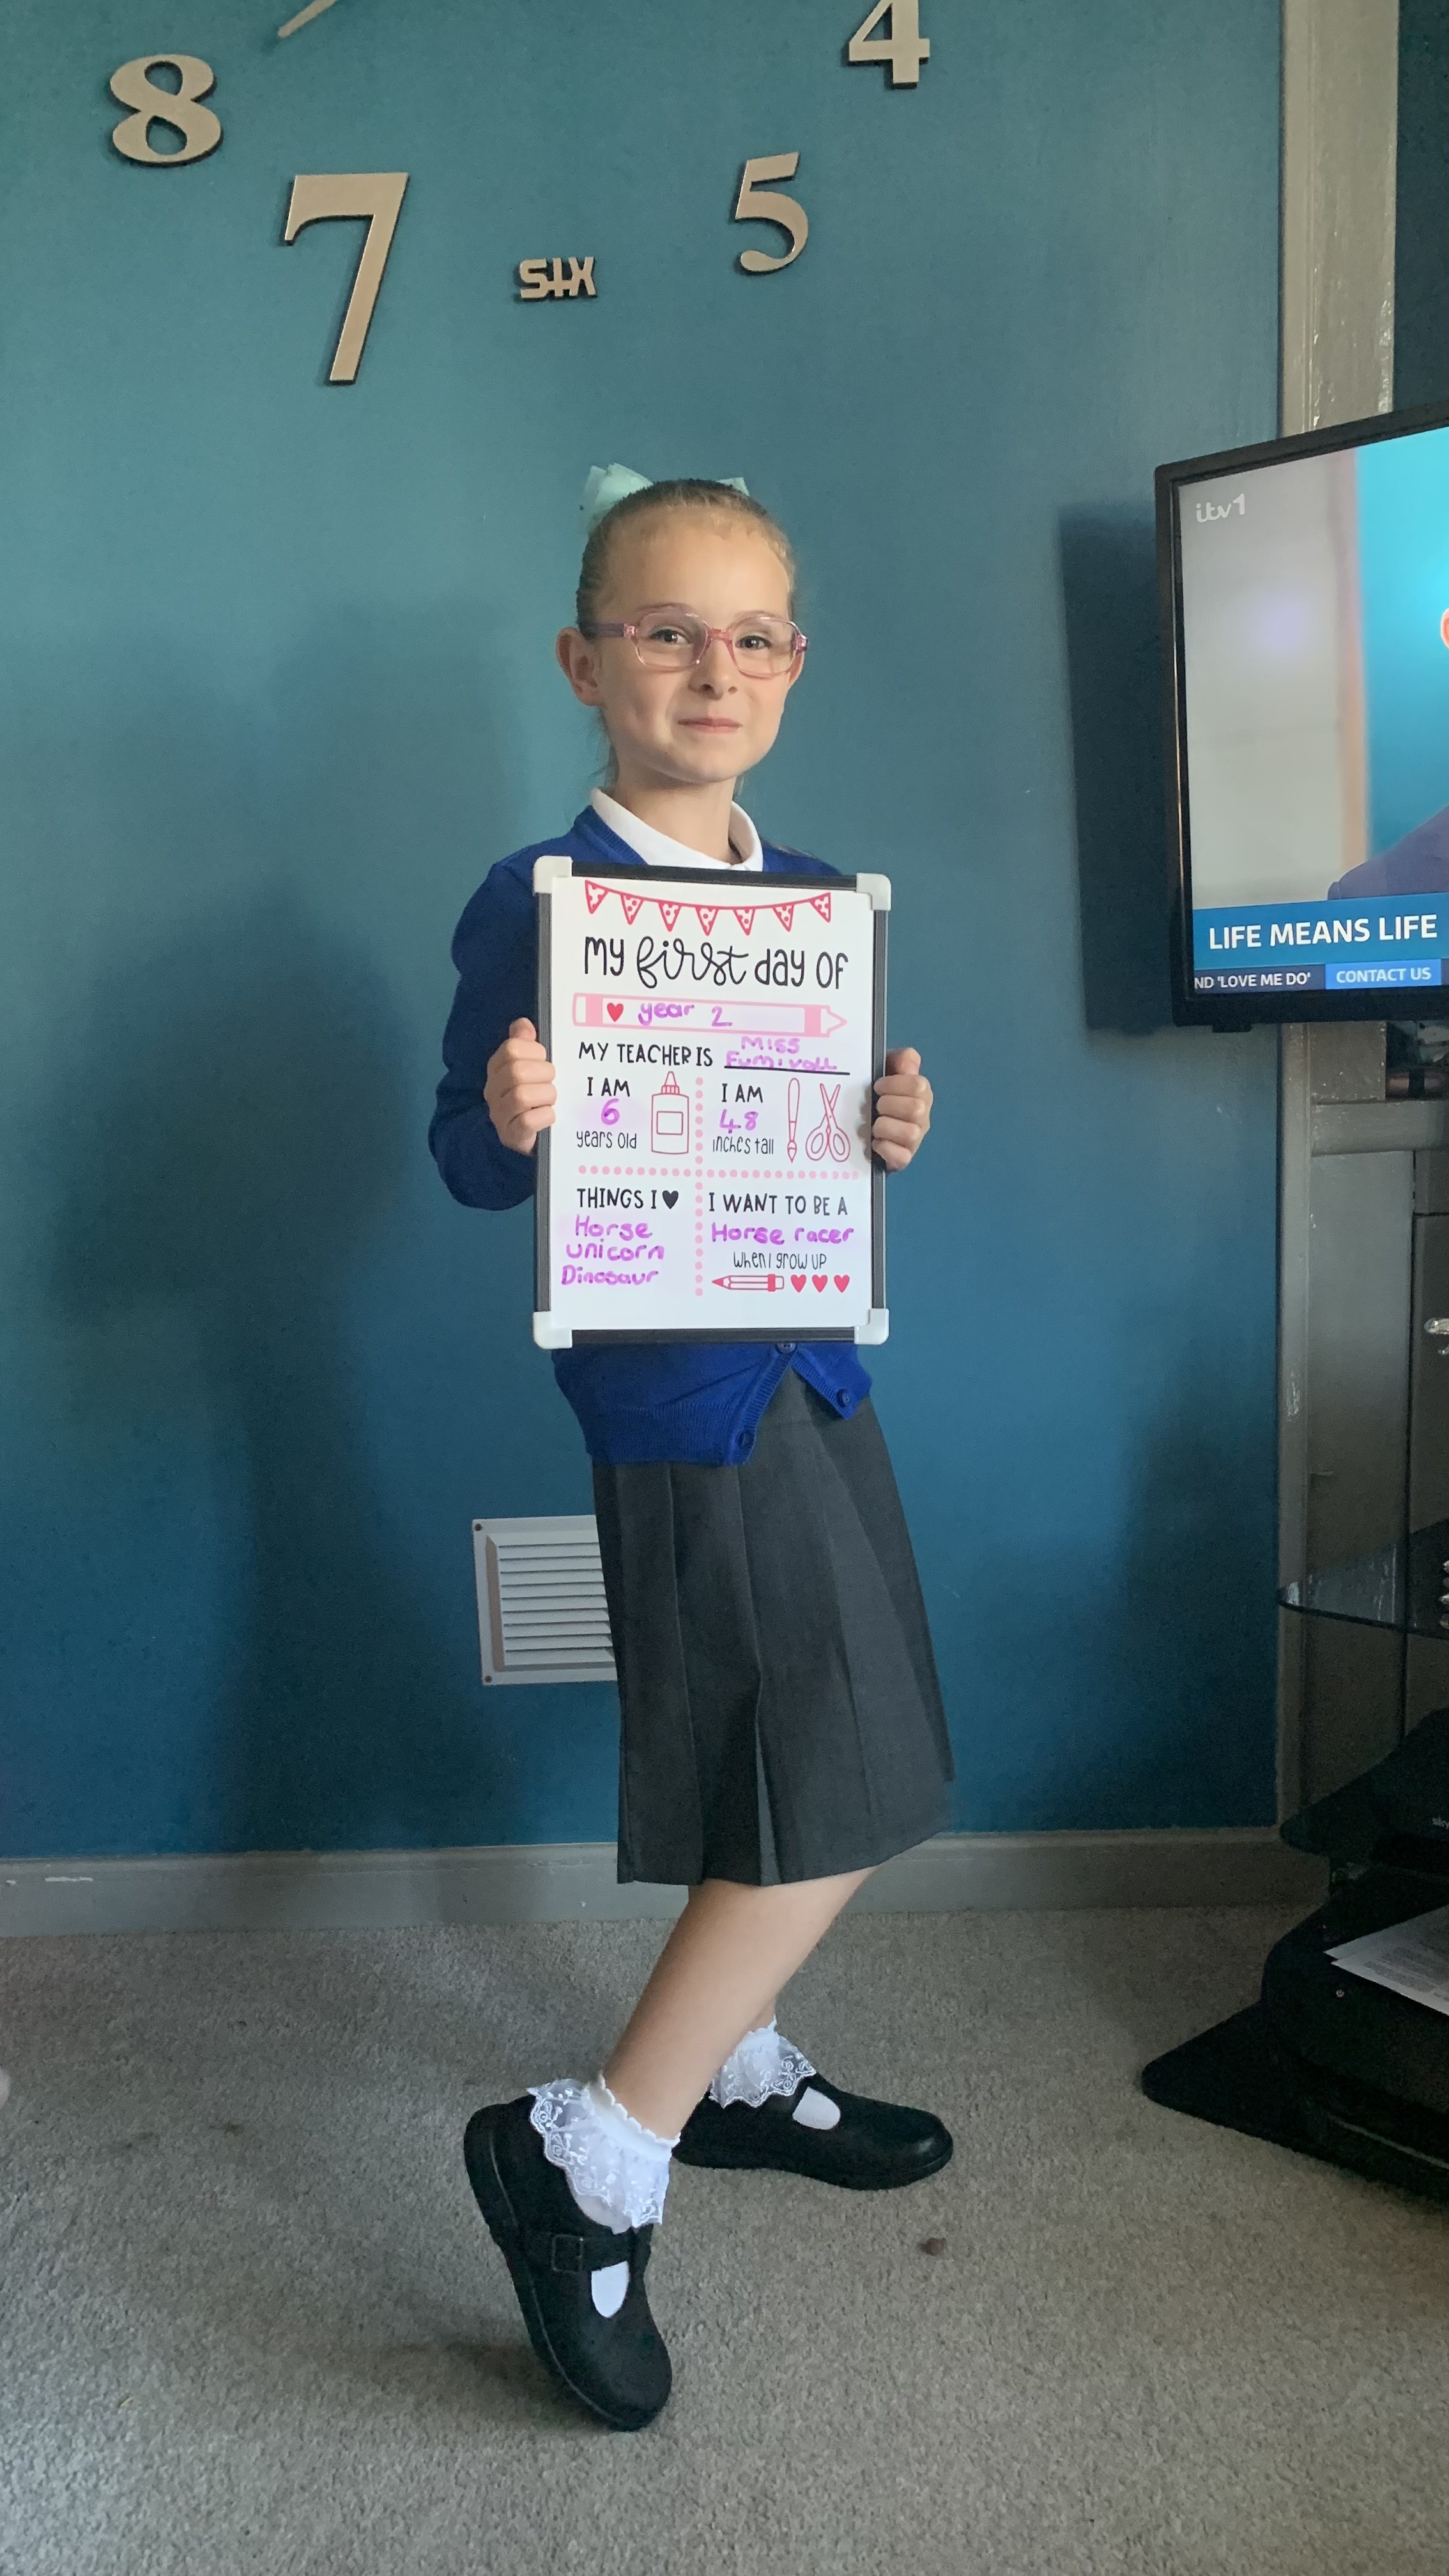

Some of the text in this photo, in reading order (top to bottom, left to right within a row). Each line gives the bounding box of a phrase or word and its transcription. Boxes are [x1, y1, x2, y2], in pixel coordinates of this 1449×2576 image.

[849, 0, 930, 84] 4
[109, 54, 222, 165] 8
[735, 151, 809, 273] 5
[284, 172, 410, 383] 7
[519, 256, 597, 298] SIX
[1195, 493, 1246, 523] itv1
[1209, 914, 1438, 949] LIFE MEANS LIFE
[636, 935, 749, 989] first
[754, 948, 805, 987] day
[1261, 973, 1283, 986] ME
[1336, 967, 1432, 984] CONTACT US
[638, 1002, 733, 1027] year 2
[578, 1041, 714, 1067] MY TEACHER IS
[586, 1077, 631, 1097] I AM
[721, 1083, 763, 1103] I AM
[601, 1098, 620, 1126] 6
[719, 1109, 759, 1134] 48
[576, 1130, 613, 1149] years
[712, 1135, 774, 1154] inches tall
[576, 1186, 657, 1209] THINGS I
[709, 1192, 848, 1216] I WANT TO BE A
[575, 1214, 654, 1241] Horse
[711, 1222, 855, 1245] Horse racer
[776, 1252, 808, 1270] grow
[560, 1264, 659, 1285] Dinosaur
